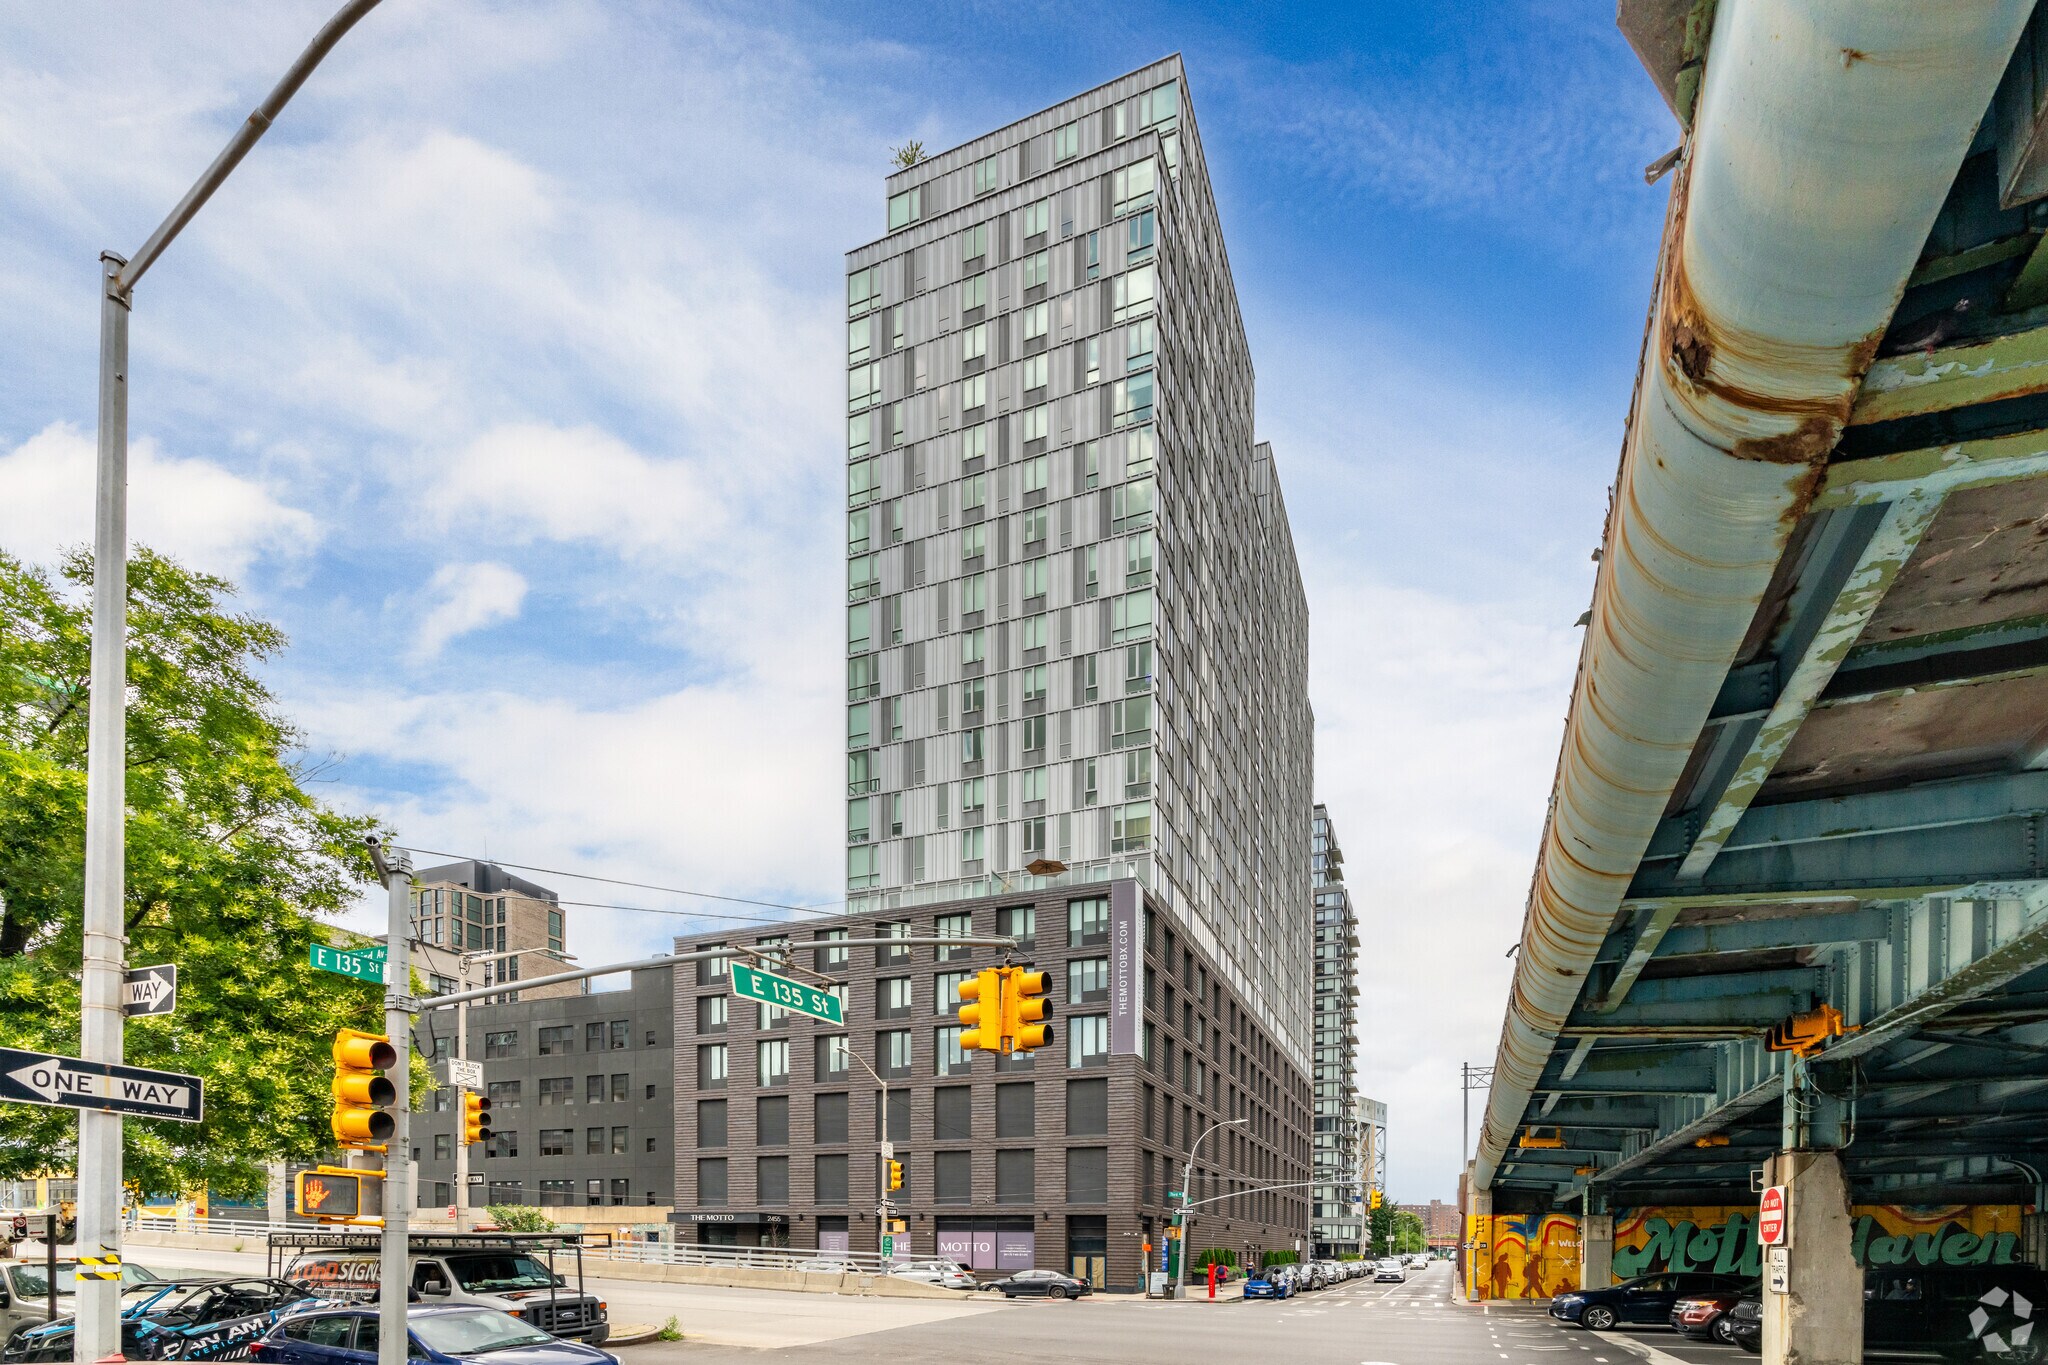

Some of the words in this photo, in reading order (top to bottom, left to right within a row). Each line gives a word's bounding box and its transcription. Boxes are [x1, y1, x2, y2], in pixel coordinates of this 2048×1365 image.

[317, 948, 327, 967] E
[335, 953, 362, 975] 135
[368, 961, 380, 974] St
[1118, 920, 1128, 1017] THEMOTTOBX.COM
[131, 981, 162, 1001] WAY
[751, 974, 765, 996] E
[772, 981, 804, 1007] 135
[811, 994, 829, 1015] St
[31, 1069, 93, 1094] ONE
[122, 1081, 179, 1104] WAY
[1763, 1200, 1769, 1209] DO
[1770, 1198, 1780, 1208] NOT
[1763, 1223, 1778, 1233] ENTER
[940, 1241, 990, 1253] MOTTO
[1774, 1251, 1784, 1263] ALL
[228, 1317, 264, 1340] AM
[251, 1327, 266, 1338] X3
